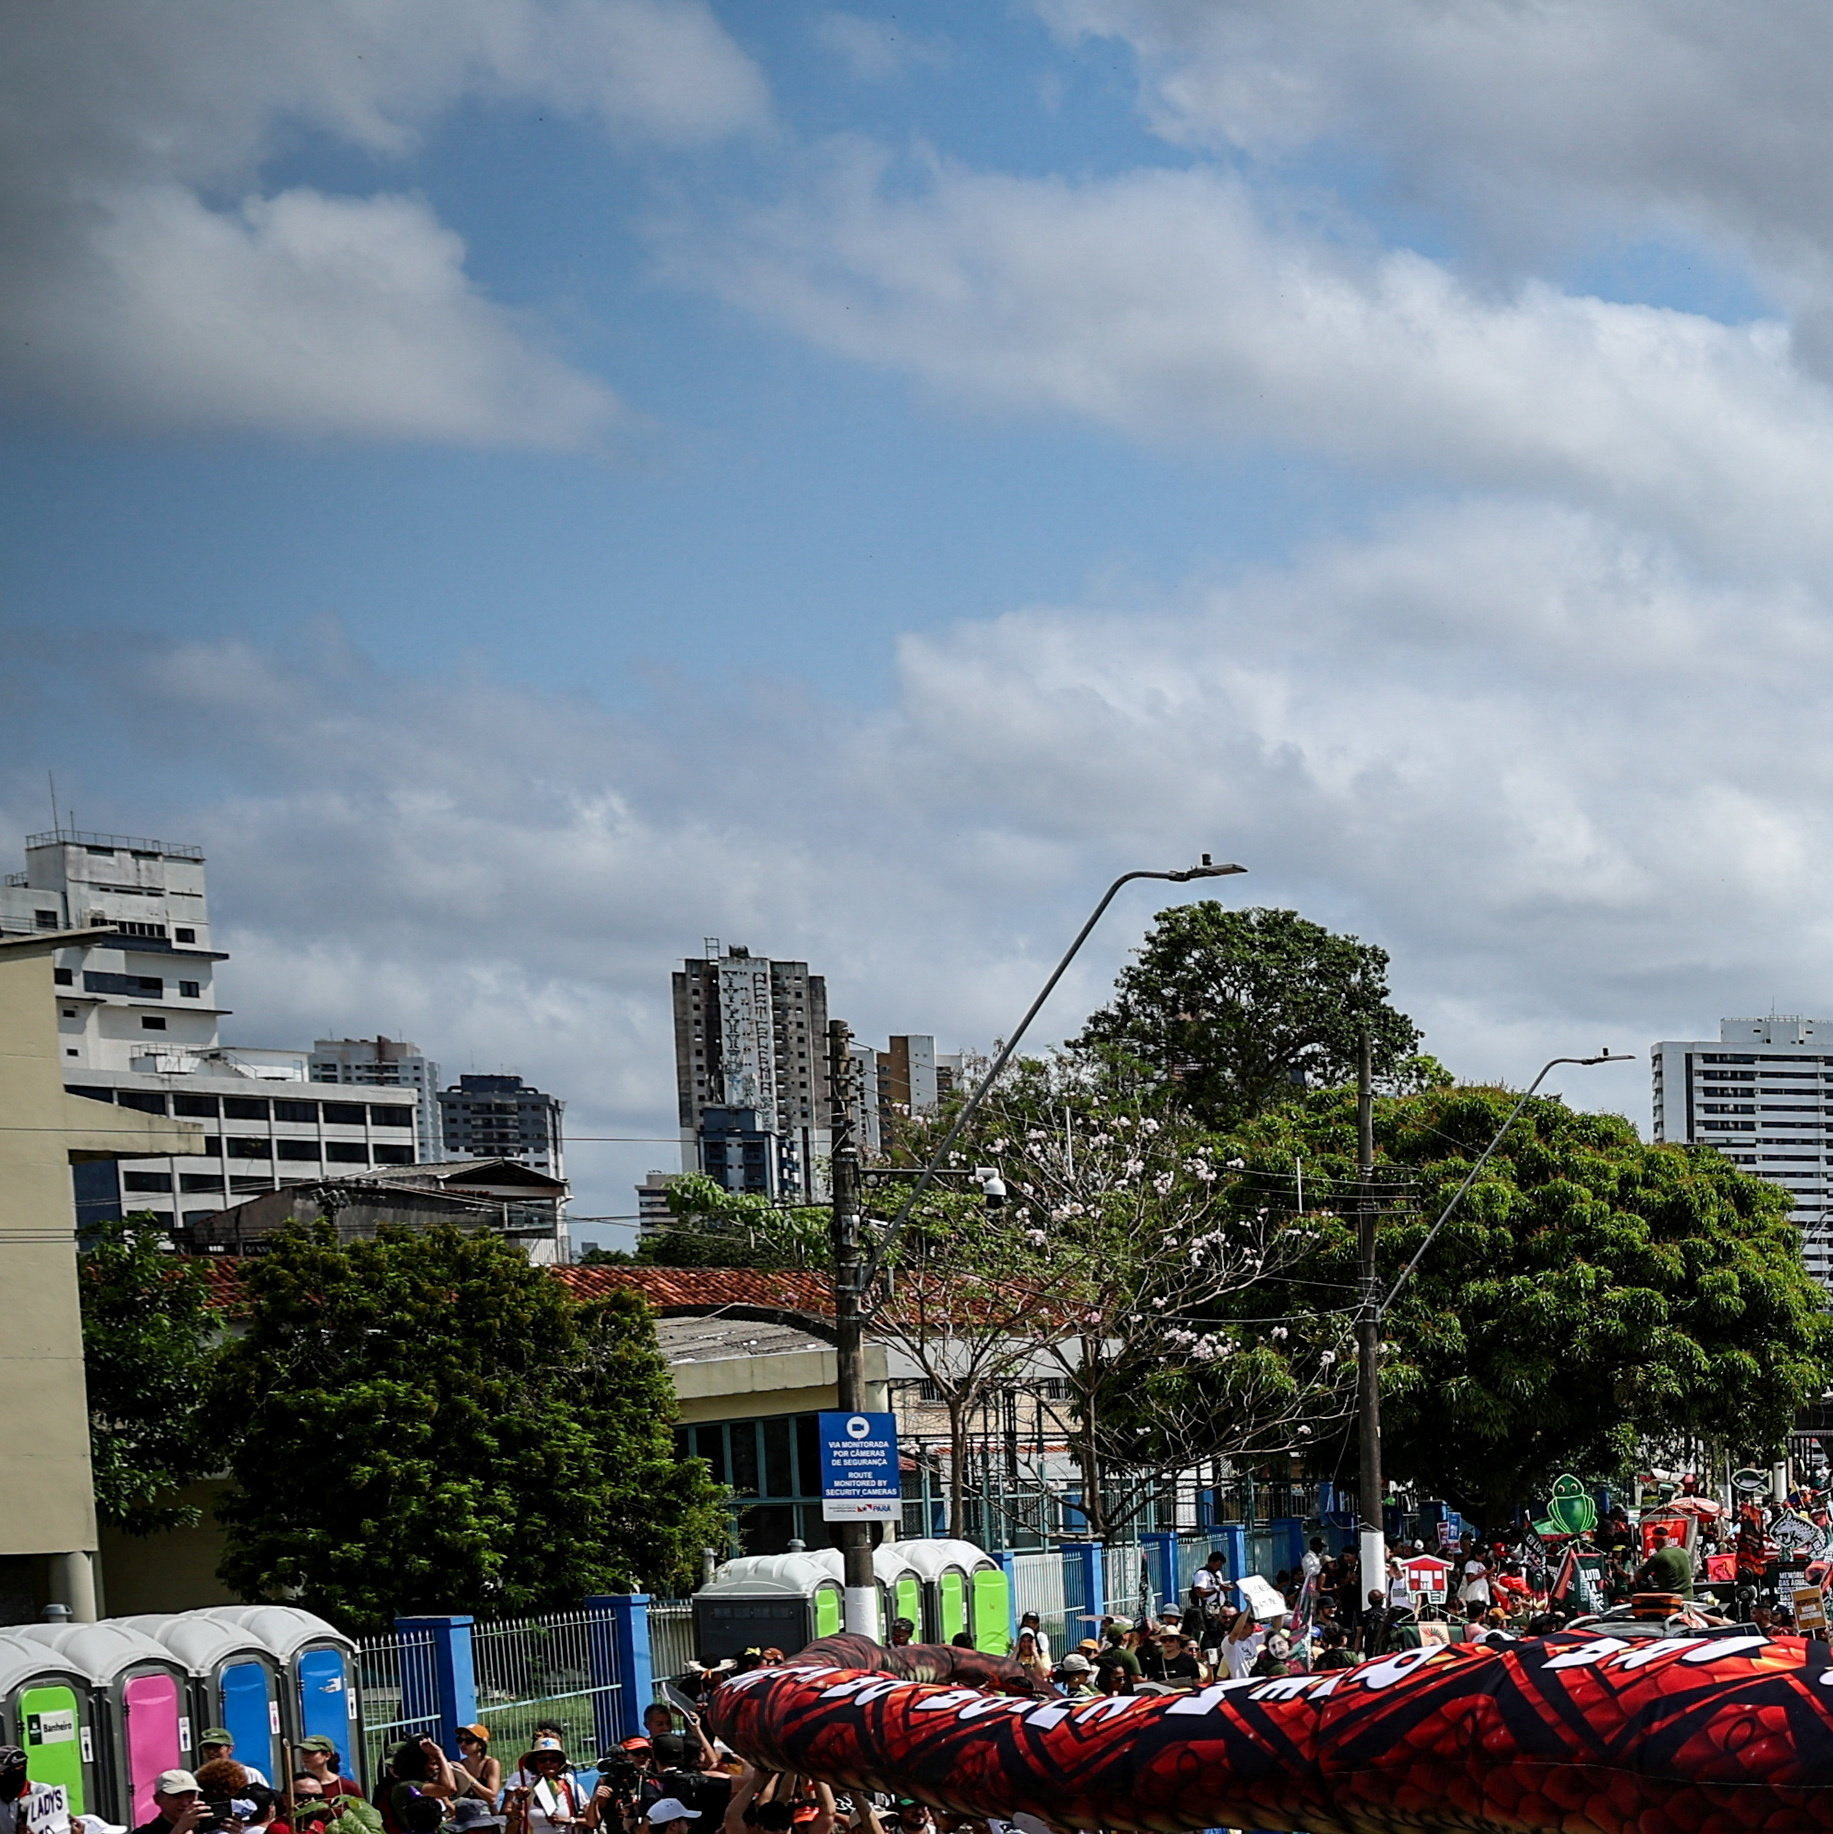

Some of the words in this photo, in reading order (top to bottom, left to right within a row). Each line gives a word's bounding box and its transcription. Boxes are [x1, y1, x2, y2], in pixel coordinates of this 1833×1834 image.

[833, 1449, 849, 1457] POR
[850, 1447, 885, 1457] CÂMERAS
[832, 1458, 842, 1466] DE
[843, 1458, 888, 1468] SEGURANÇA
[848, 1471, 873, 1479] ROUTE
[834, 1480, 877, 1488] MONITORED
[826, 1488, 861, 1497] SECURITY
[862, 1488, 898, 1496] CAMERAS
[43, 1722, 72, 1734] Banheiro
